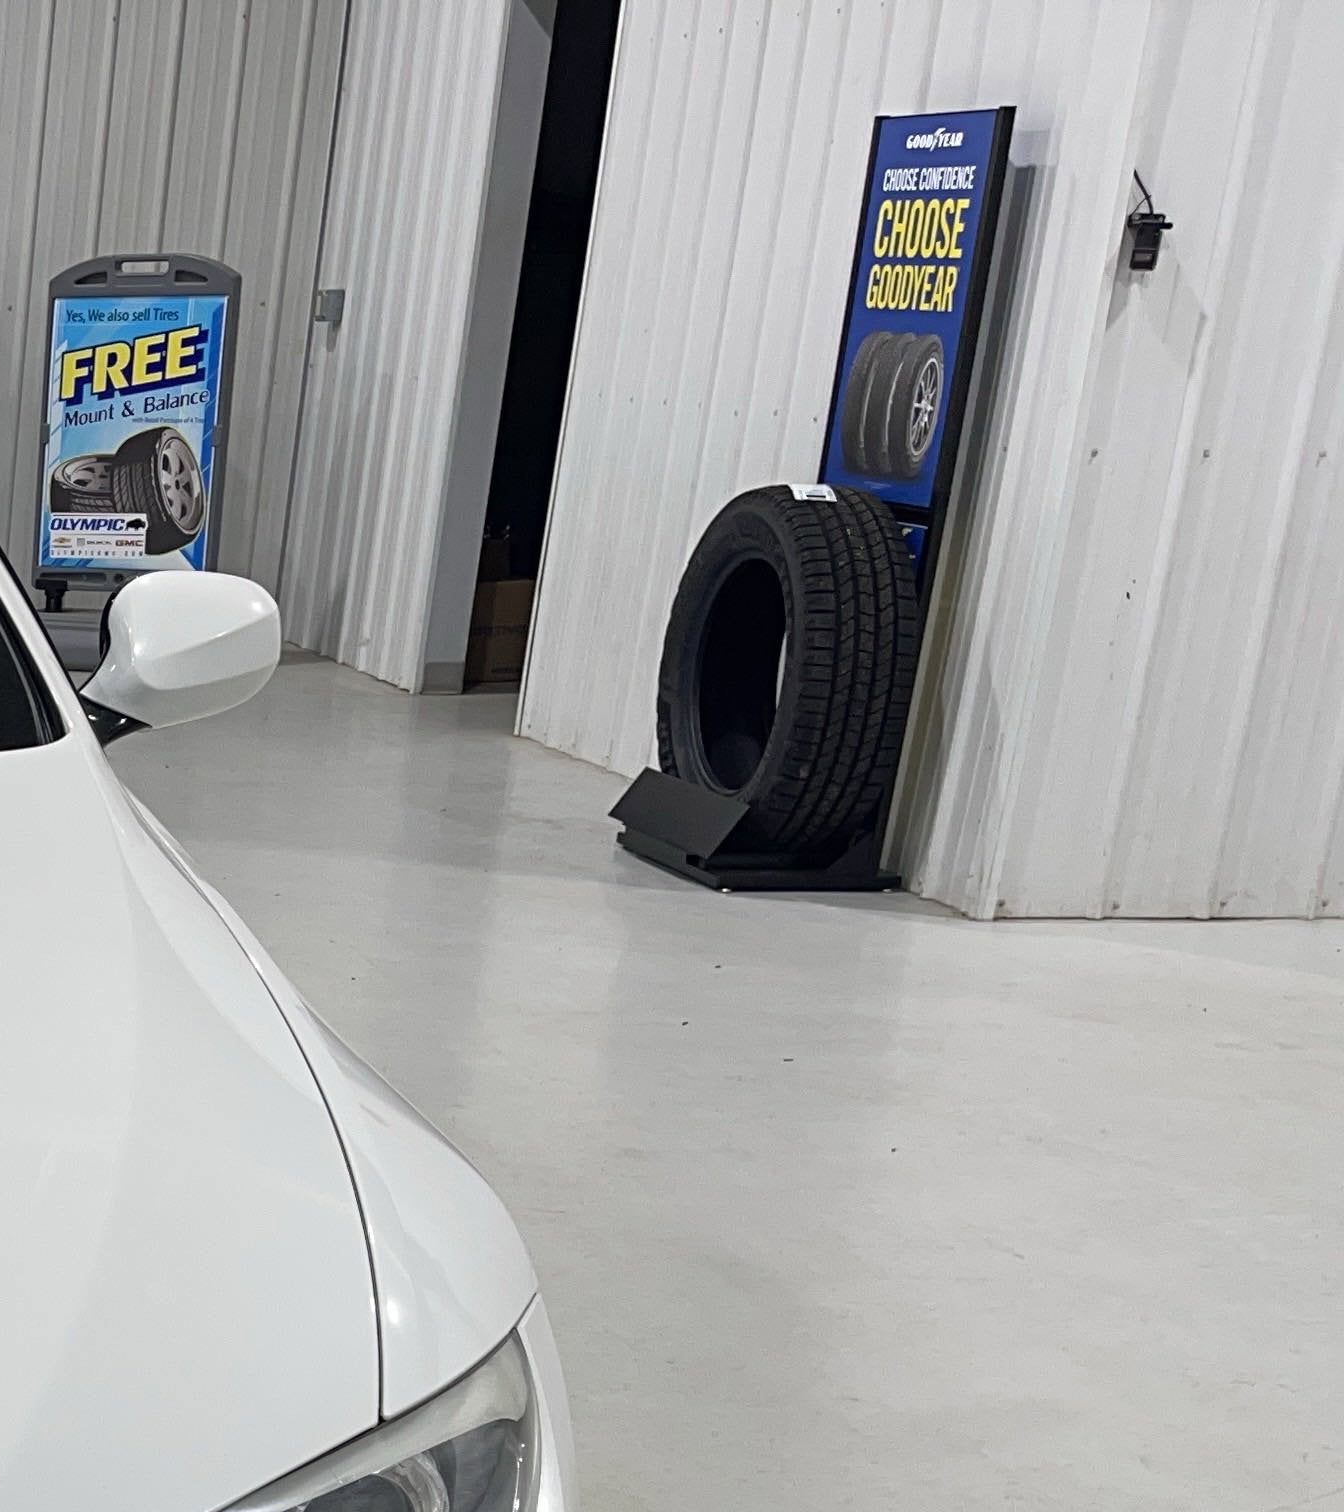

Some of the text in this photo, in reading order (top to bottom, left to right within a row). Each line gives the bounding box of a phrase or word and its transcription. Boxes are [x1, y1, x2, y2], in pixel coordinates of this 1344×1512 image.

[906, 128, 963, 151] GOODYEAR
[882, 165, 976, 191] CHOOSE CONFIDENCE
[874, 198, 971, 259] CHOOSE
[865, 264, 958, 312] GOODYEAR
[65, 308, 179, 323] Yes, We also sell Tires
[59, 324, 204, 403] FREE
[64, 389, 209, 427] Mount & Balance
[50, 518, 125, 531] OLYMPIC
